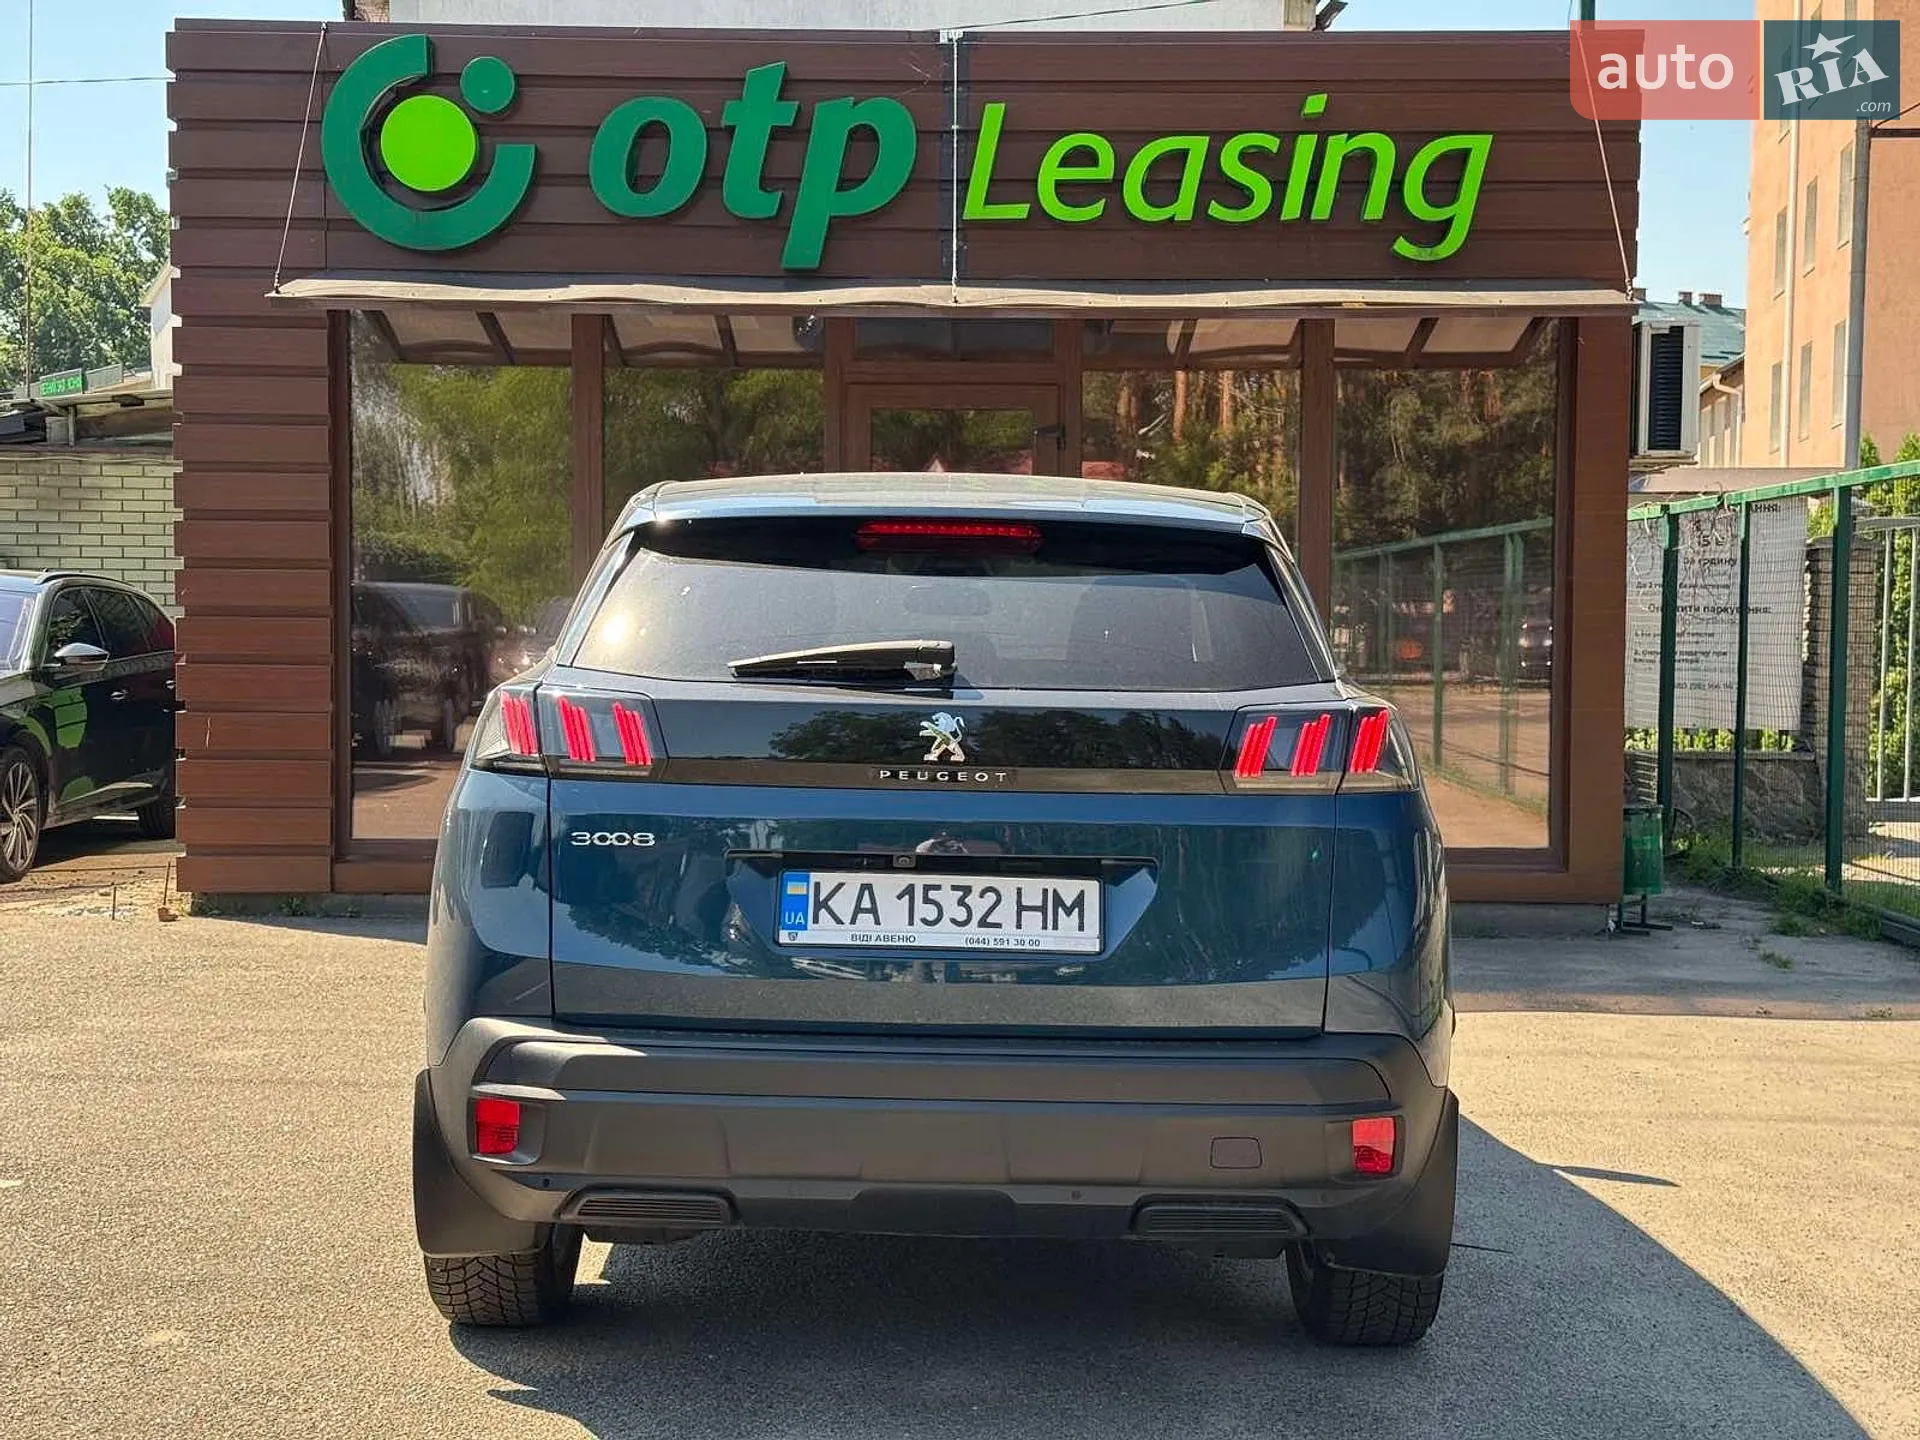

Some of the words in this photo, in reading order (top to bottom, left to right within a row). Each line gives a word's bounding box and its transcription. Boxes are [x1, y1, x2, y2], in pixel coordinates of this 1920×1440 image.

[589, 61, 918, 271] otp
[962, 93, 1493, 261] Leasing
[879, 770, 1007, 783] PEUGEOT
[571, 831, 656, 847] 3008
[811, 881, 882, 926] KA
[895, 883, 1003, 929] 1532
[1015, 886, 1086, 932] HM
[785, 912, 806, 926] UA
[874, 933, 917, 944] АВЕНЮ
[965, 936, 990, 947] (044)
